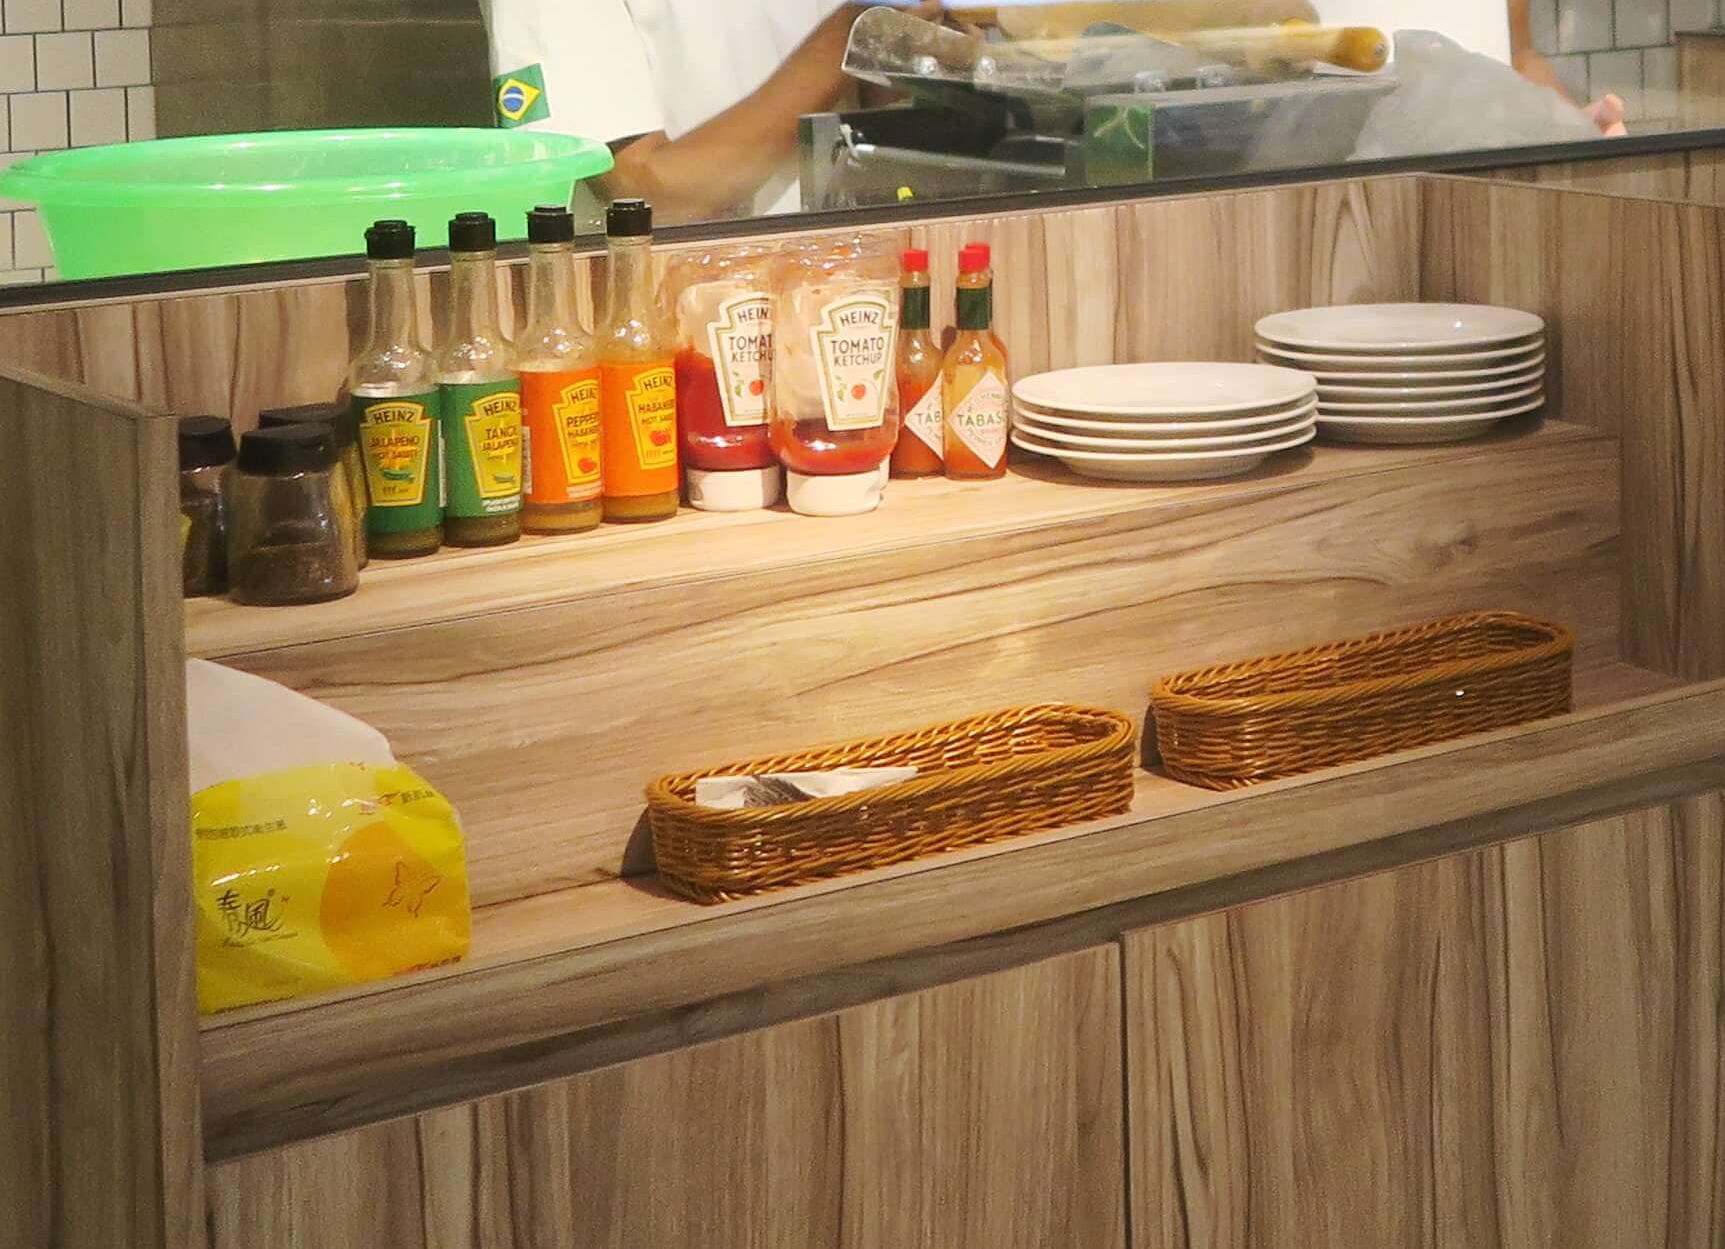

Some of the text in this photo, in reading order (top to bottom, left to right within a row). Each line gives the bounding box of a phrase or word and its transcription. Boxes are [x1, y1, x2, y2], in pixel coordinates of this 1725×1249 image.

[737, 307, 769, 322] HEIN
[839, 310, 880, 327] HEINZ
[728, 334, 773, 351] TOMAT
[831, 336, 886, 355] TOMATO
[731, 351, 773, 363] KETCHU
[833, 353, 884, 367] KETCHUP
[643, 375, 674, 391] HEINZ
[483, 398, 519, 416] HEINZ
[373, 410, 416, 425] HEINZ
[566, 412, 600, 429] PEPPE
[915, 411, 943, 424] TAB
